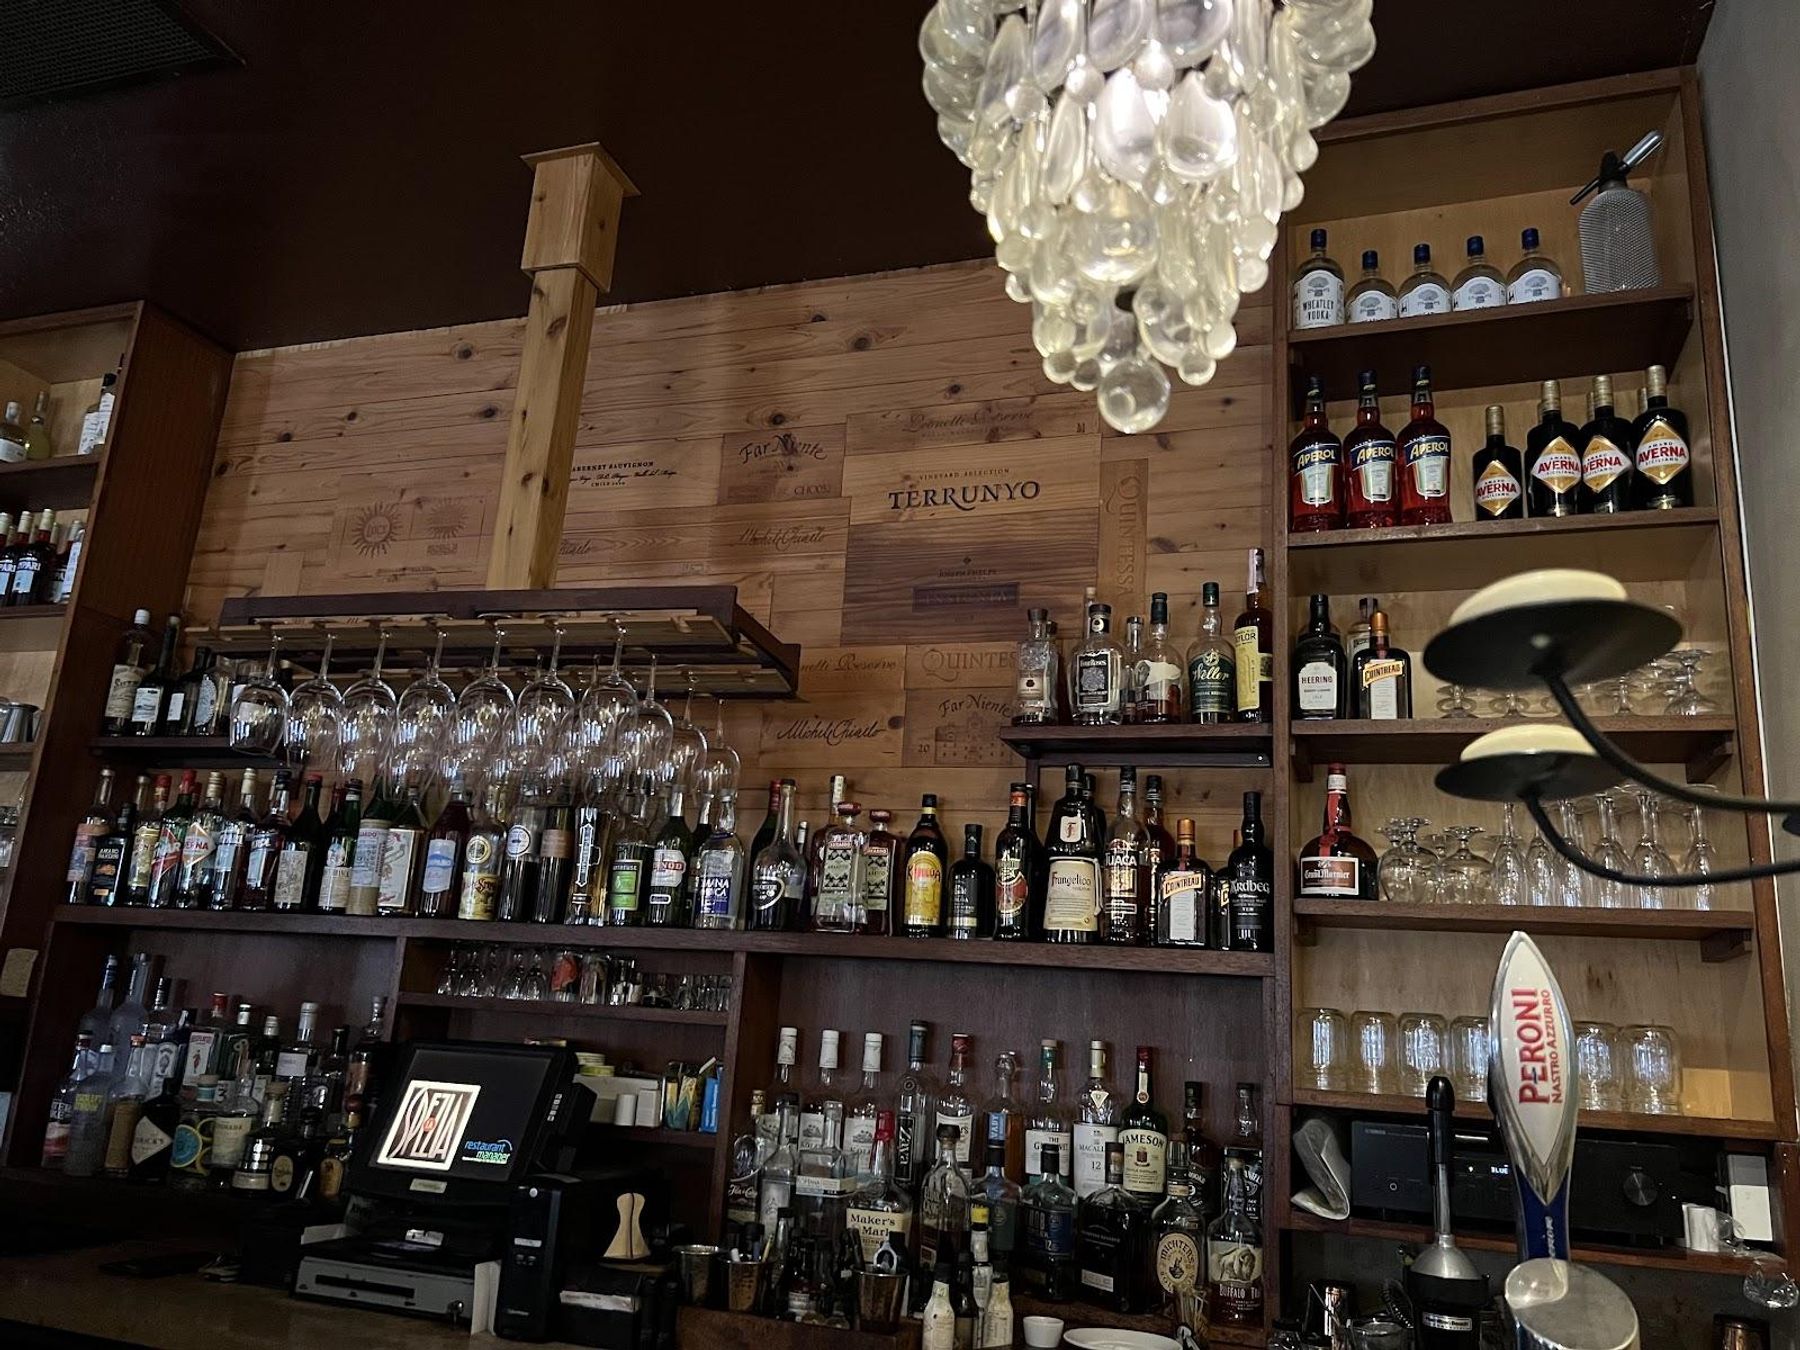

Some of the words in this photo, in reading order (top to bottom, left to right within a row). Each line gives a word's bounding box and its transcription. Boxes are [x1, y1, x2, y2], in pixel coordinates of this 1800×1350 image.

[1307, 309, 1329, 321] VODKA
[739, 442, 770, 465] Far
[1356, 446, 1394, 464] APEROL
[1410, 441, 1449, 459] APEROL
[1638, 445, 1687, 464] AVERNA
[572, 464, 606, 472] ABERNET
[1297, 449, 1335, 470] APEROL
[1537, 460, 1581, 474] AVERNA
[888, 480, 1041, 512] TERRUNYO
[1475, 482, 1517, 498] AVERNA
[921, 648, 1018, 682] QUINTES
[1193, 663, 1229, 681] Weller
[1364, 663, 1401, 683] COINTREAU
[1301, 675, 1333, 684] HEERING
[938, 697, 966, 718] Far
[967, 693, 1014, 719] Niente
[1104, 852, 1138, 867] TUACA
[1051, 870, 1092, 888] Frangelico
[1165, 875, 1200, 894] COINTREAU
[1540, 989, 1559, 1049] AZZURRO
[1511, 988, 1551, 1105] PERONI
[1549, 1051, 1563, 1104] NASTRO
[464, 1139, 507, 1153] restaurant
[898, 1125, 913, 1165] Zaya
[1121, 1133, 1165, 1148] JAMESON
[475, 1150, 511, 1162] manager
[1091, 1161, 1102, 1170] 12
[850, 1213, 896, 1226] Maker's
[1219, 1283, 1246, 1299] BUFFALO
